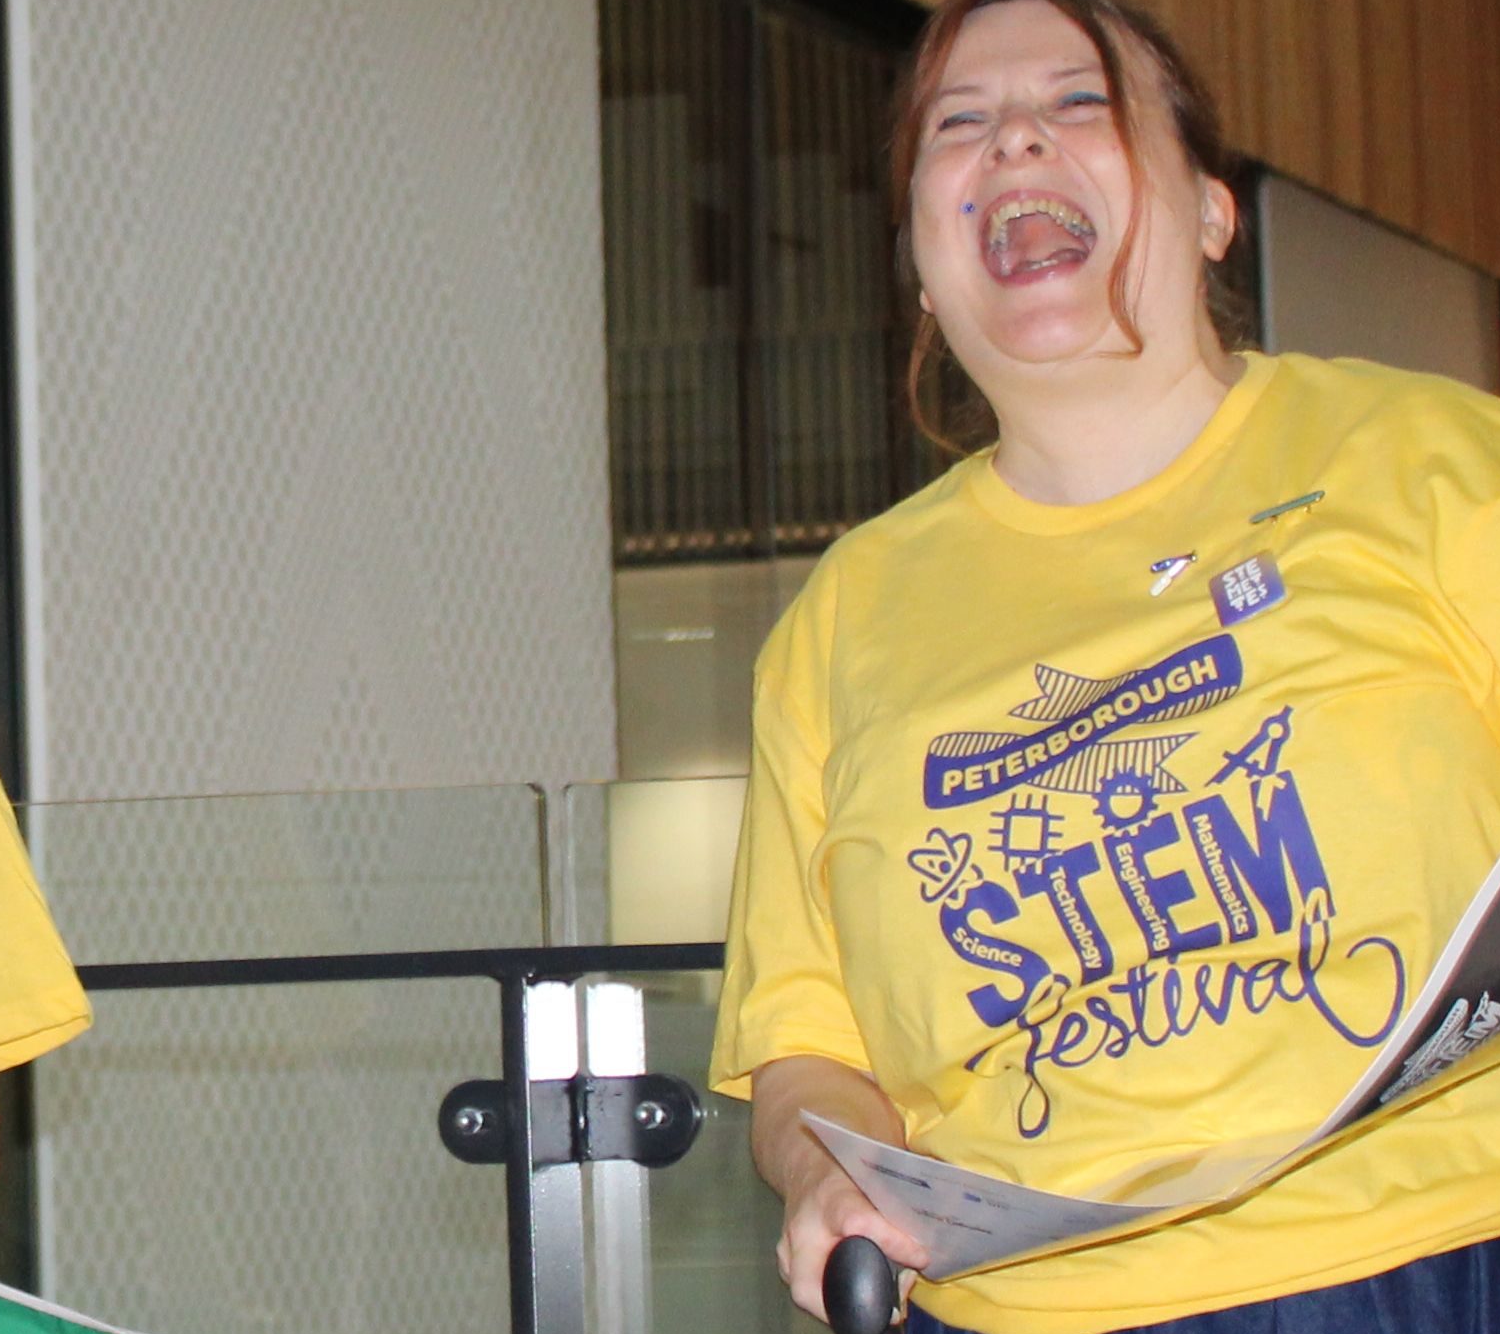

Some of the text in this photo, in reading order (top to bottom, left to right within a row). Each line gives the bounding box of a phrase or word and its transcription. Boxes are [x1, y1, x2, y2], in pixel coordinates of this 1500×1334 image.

[941, 654, 1219, 797] PETERBOROUGH
[939, 770, 1337, 1029] STEM
[1047, 866, 1103, 970] Technology
[1113, 842, 1171, 953] Engineering
[1192, 813, 1249, 937] Mathematics
[952, 925, 1024, 969] Science
